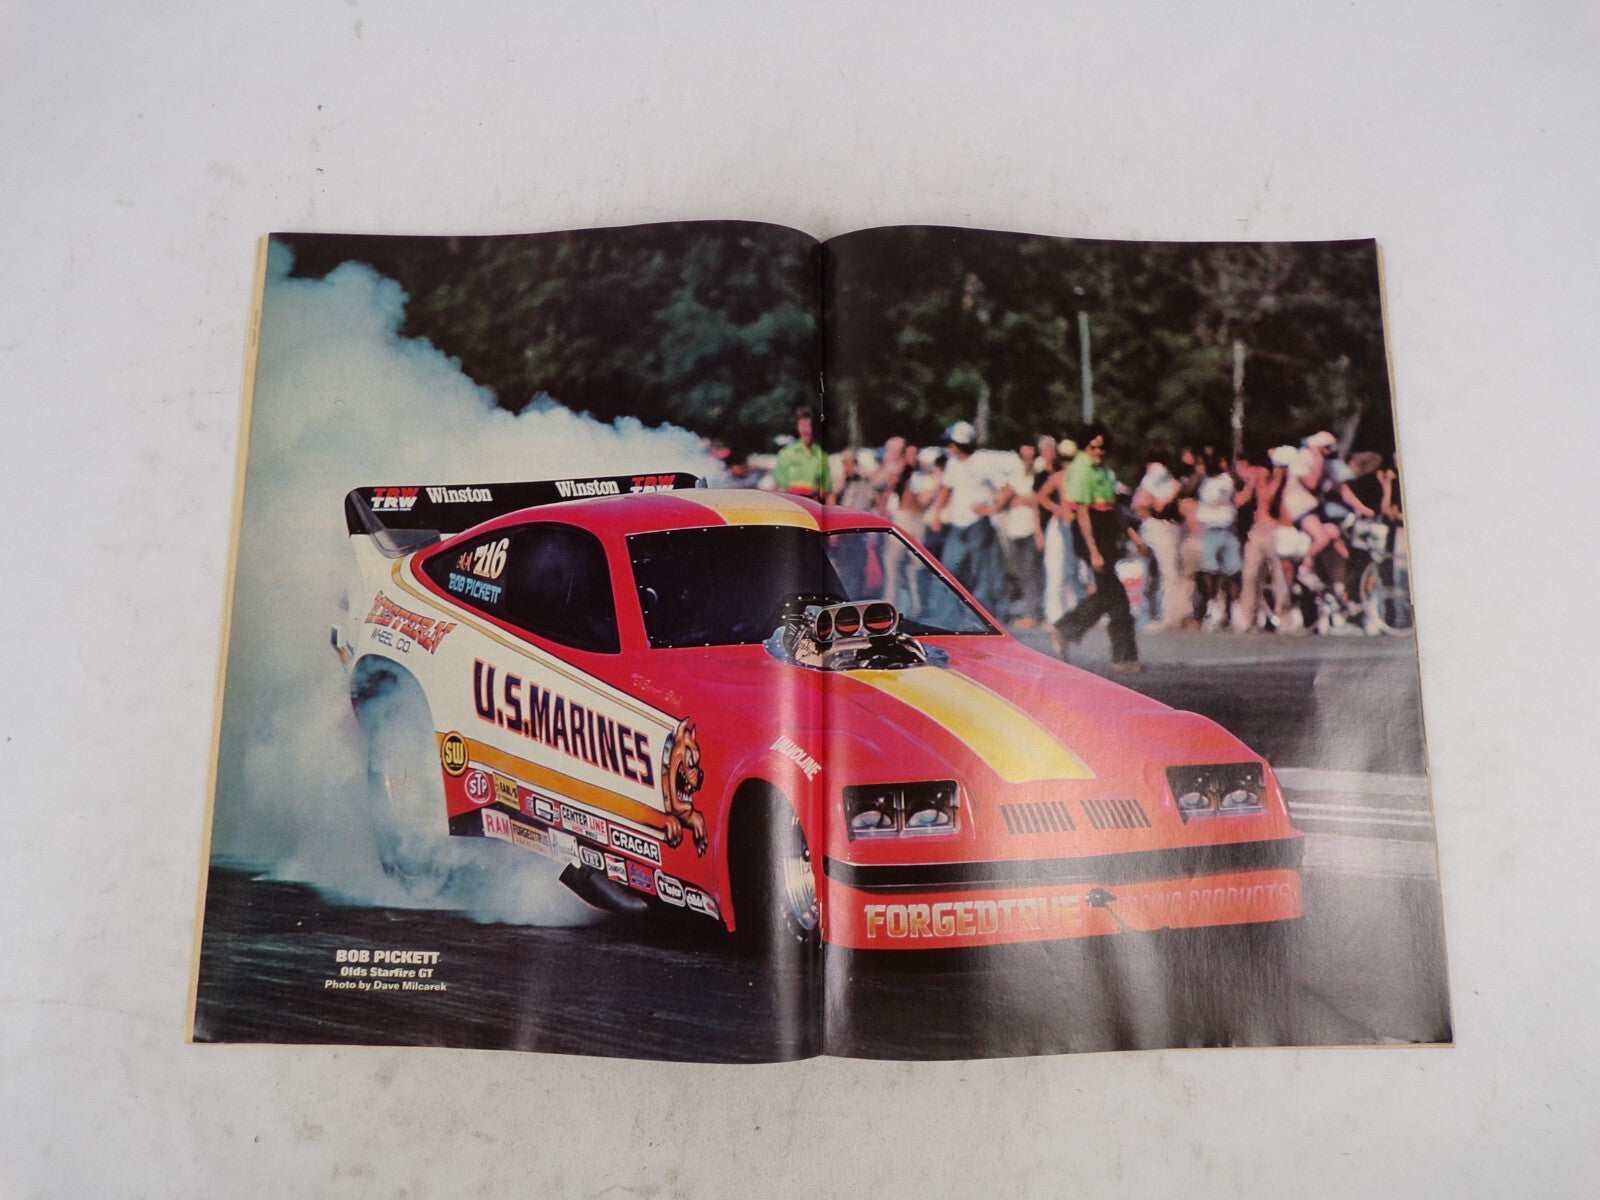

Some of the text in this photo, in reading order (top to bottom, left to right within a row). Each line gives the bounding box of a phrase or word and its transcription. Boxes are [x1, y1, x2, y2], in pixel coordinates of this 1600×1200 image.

[425, 486, 493, 504] Winston
[555, 480, 620, 498] Winston
[371, 497, 417, 508] TRW
[473, 537, 510, 579] 716
[448, 572, 502, 604] BOB PICKETT
[371, 629, 394, 647] WHEEL
[444, 741, 465, 765] SW
[469, 773, 488, 796] STP
[484, 813, 511, 837] RAM
[561, 806, 589, 827] CENTER
[588, 816, 606, 835] LINE
[611, 830, 659, 861] CRAGAR
[864, 895, 1084, 938] FORGEDTRUE
[335, 949, 440, 965] BOB PICKETT
[340, 966, 434, 978] Olds Starfire GT
[324, 980, 447, 991] Photo by Dave Milcarek
